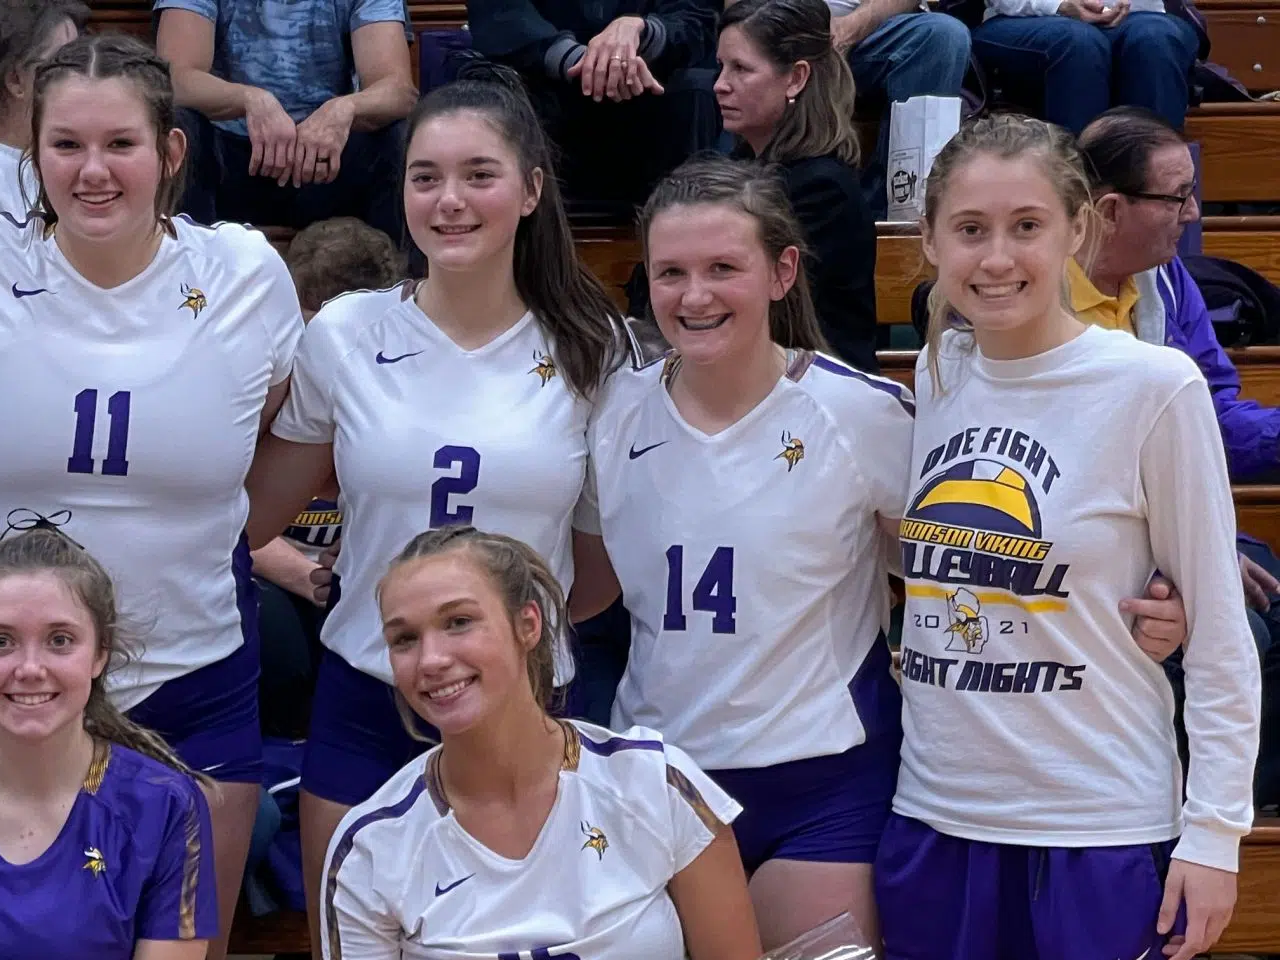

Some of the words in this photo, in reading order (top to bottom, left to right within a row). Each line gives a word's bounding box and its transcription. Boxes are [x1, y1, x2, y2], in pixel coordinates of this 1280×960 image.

[67, 389, 130, 476] 11
[920, 427, 981, 480] ONE
[980, 427, 1061, 495] FIGHT
[429, 445, 481, 529] 2
[975, 531, 1054, 561] VIKING
[663, 545, 737, 634] 14
[914, 614, 939, 628] 20
[999, 620, 1029, 634] 21
[955, 660, 1086, 693] NIGHTS
